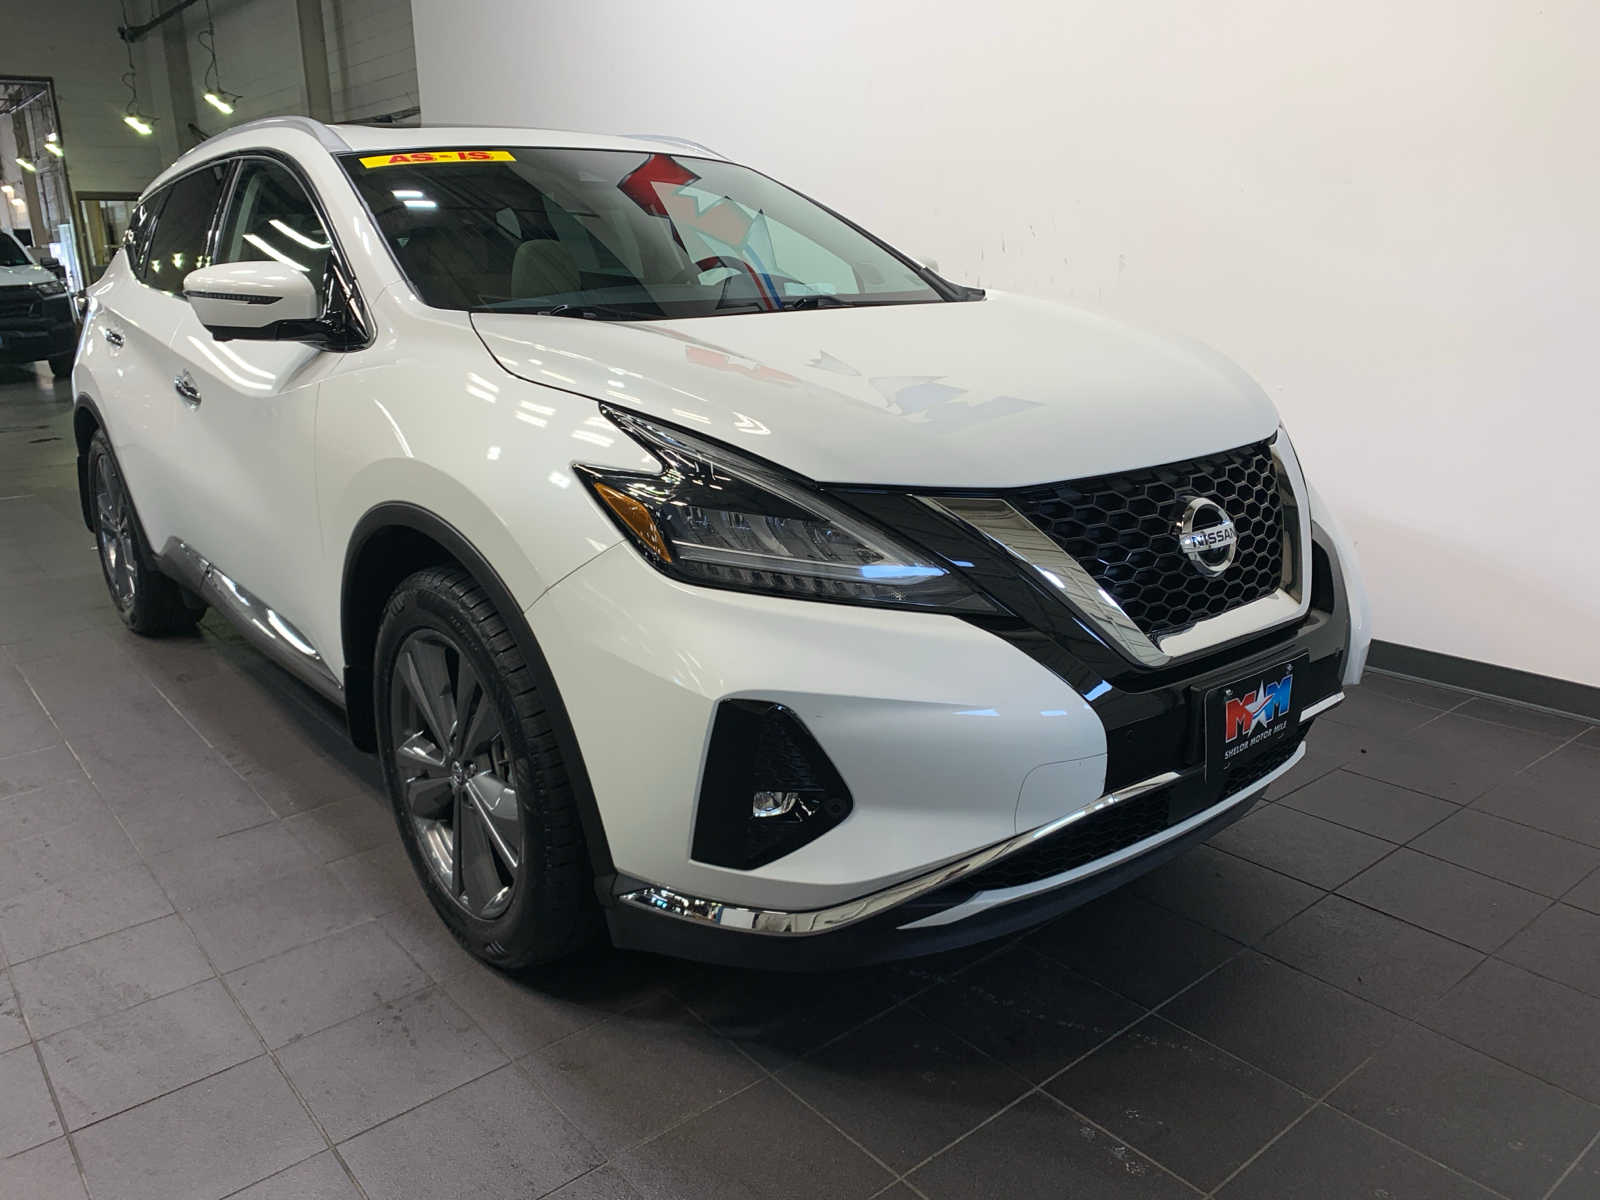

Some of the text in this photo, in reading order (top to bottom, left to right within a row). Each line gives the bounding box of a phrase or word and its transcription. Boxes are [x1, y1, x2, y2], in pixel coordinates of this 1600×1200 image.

[1191, 527, 1236, 548] NISSAN
[1224, 720, 1288, 760] SHELOR MOTOR MILE
